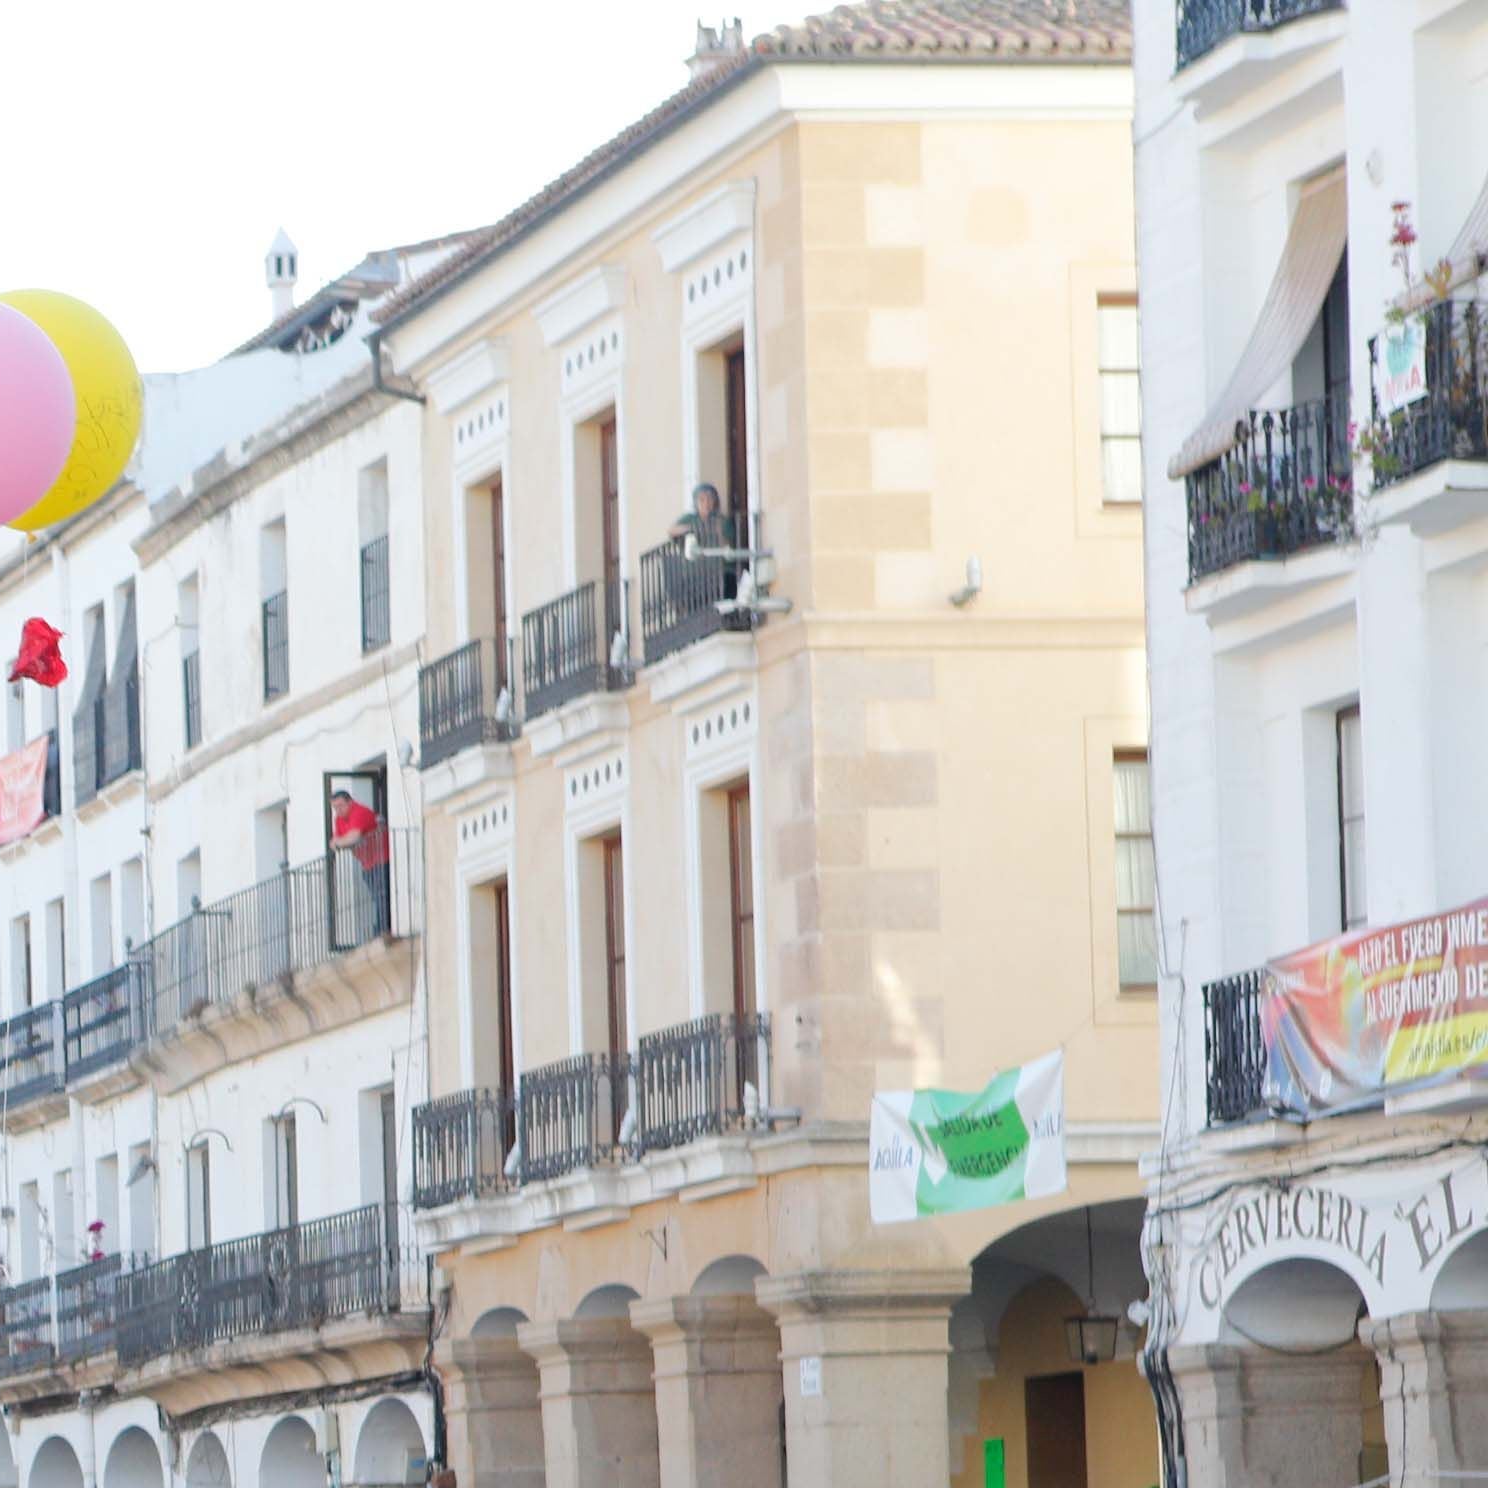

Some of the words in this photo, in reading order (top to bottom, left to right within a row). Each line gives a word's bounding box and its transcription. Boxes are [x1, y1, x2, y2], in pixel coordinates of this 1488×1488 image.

[1359, 936, 1382, 973] ALTO
[1385, 932, 1398, 963] EL
[1401, 920, 1442, 962] FUEGO
[1199, 1187, 1387, 1309] CERVECERIA
